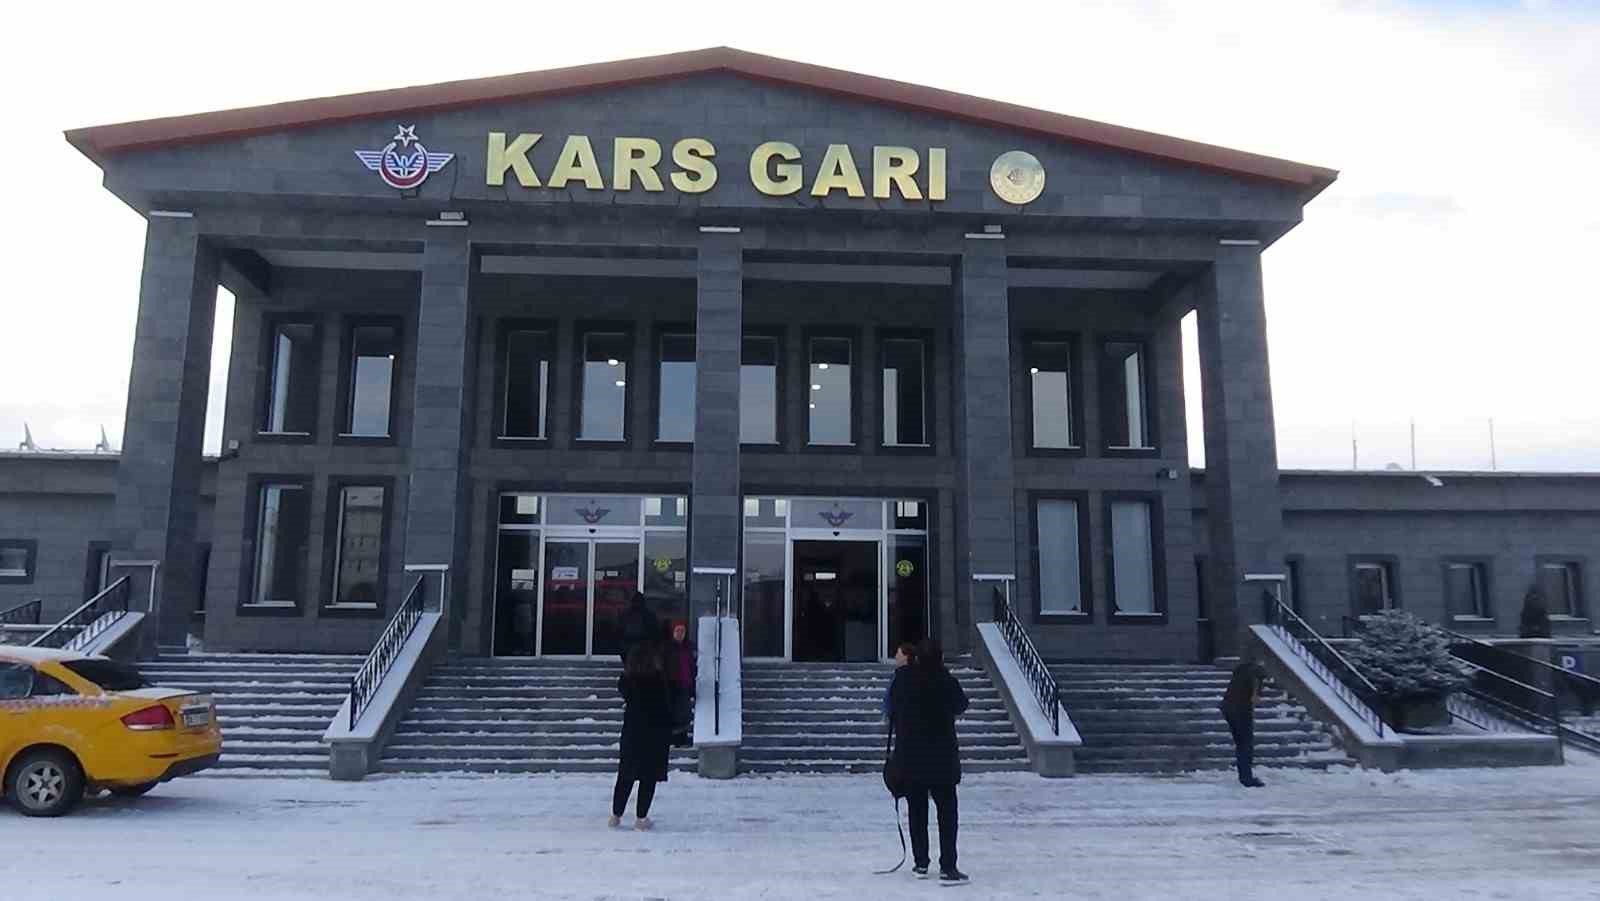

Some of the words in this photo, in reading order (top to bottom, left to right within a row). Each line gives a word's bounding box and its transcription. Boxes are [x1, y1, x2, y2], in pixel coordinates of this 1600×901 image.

[486, 132, 719, 192] KARS
[749, 141, 946, 200] GARI
[1561, 655, 1576, 669] P
